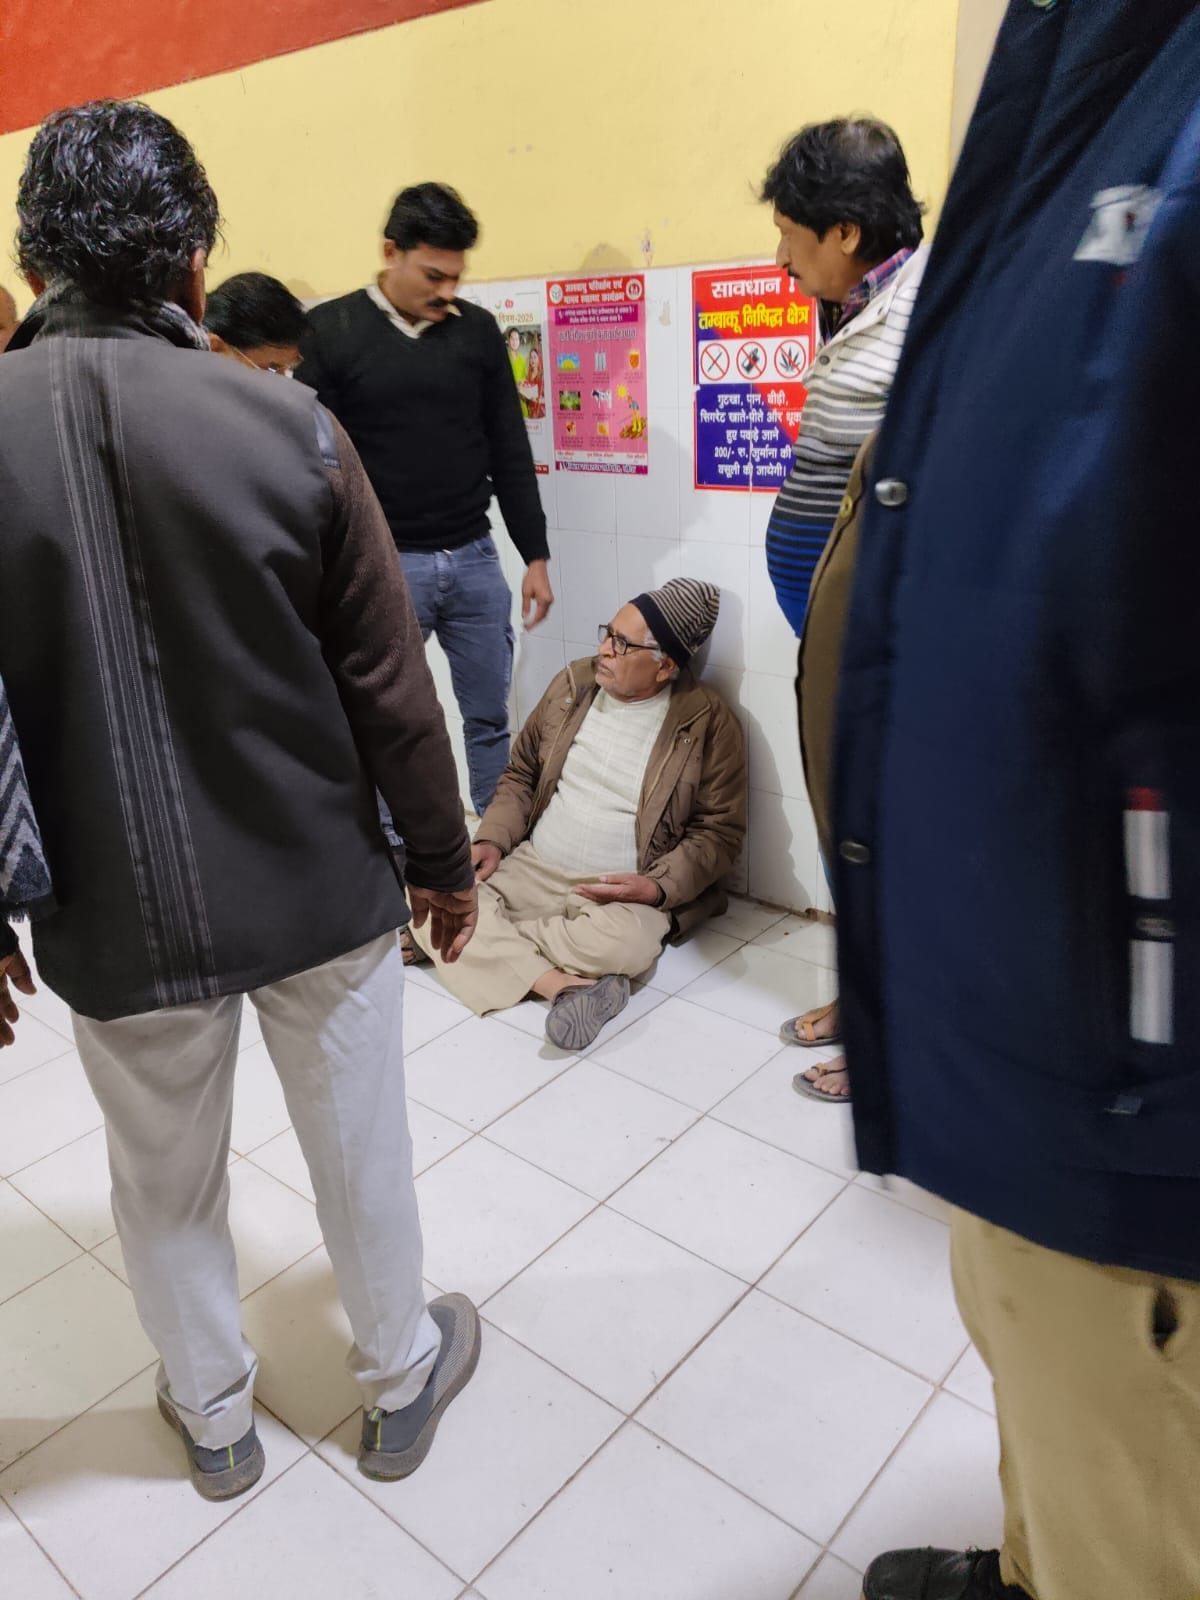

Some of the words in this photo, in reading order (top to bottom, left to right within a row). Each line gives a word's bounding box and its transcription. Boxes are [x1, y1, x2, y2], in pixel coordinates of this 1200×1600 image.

[711, 276, 781, 297] सावधान
[698, 309, 742, 333] तम्बाकू
[742, 303, 783, 327] निषिद्ध
[786, 301, 809, 324] क्षेत्र
[717, 394, 743, 408] गुटखा,
[746, 394, 764, 405] पान,
[767, 390, 788, 405] बीड़ी,
[700, 409, 726, 422] सिगरेट
[728, 408, 764, 422] खाते-पीते
[766, 409, 782, 422] और
[785, 412, 802, 426] थूक
[726, 429, 737, 444] हुए
[739, 427, 759, 442] पकड़े
[761, 427, 779, 440] जाने
[714, 447, 734, 459] 200/-
[751, 445, 777, 462] जुर्माना
[780, 445, 792, 459] की
[717, 462, 740, 478] वसूली
[742, 463, 753, 475] की
